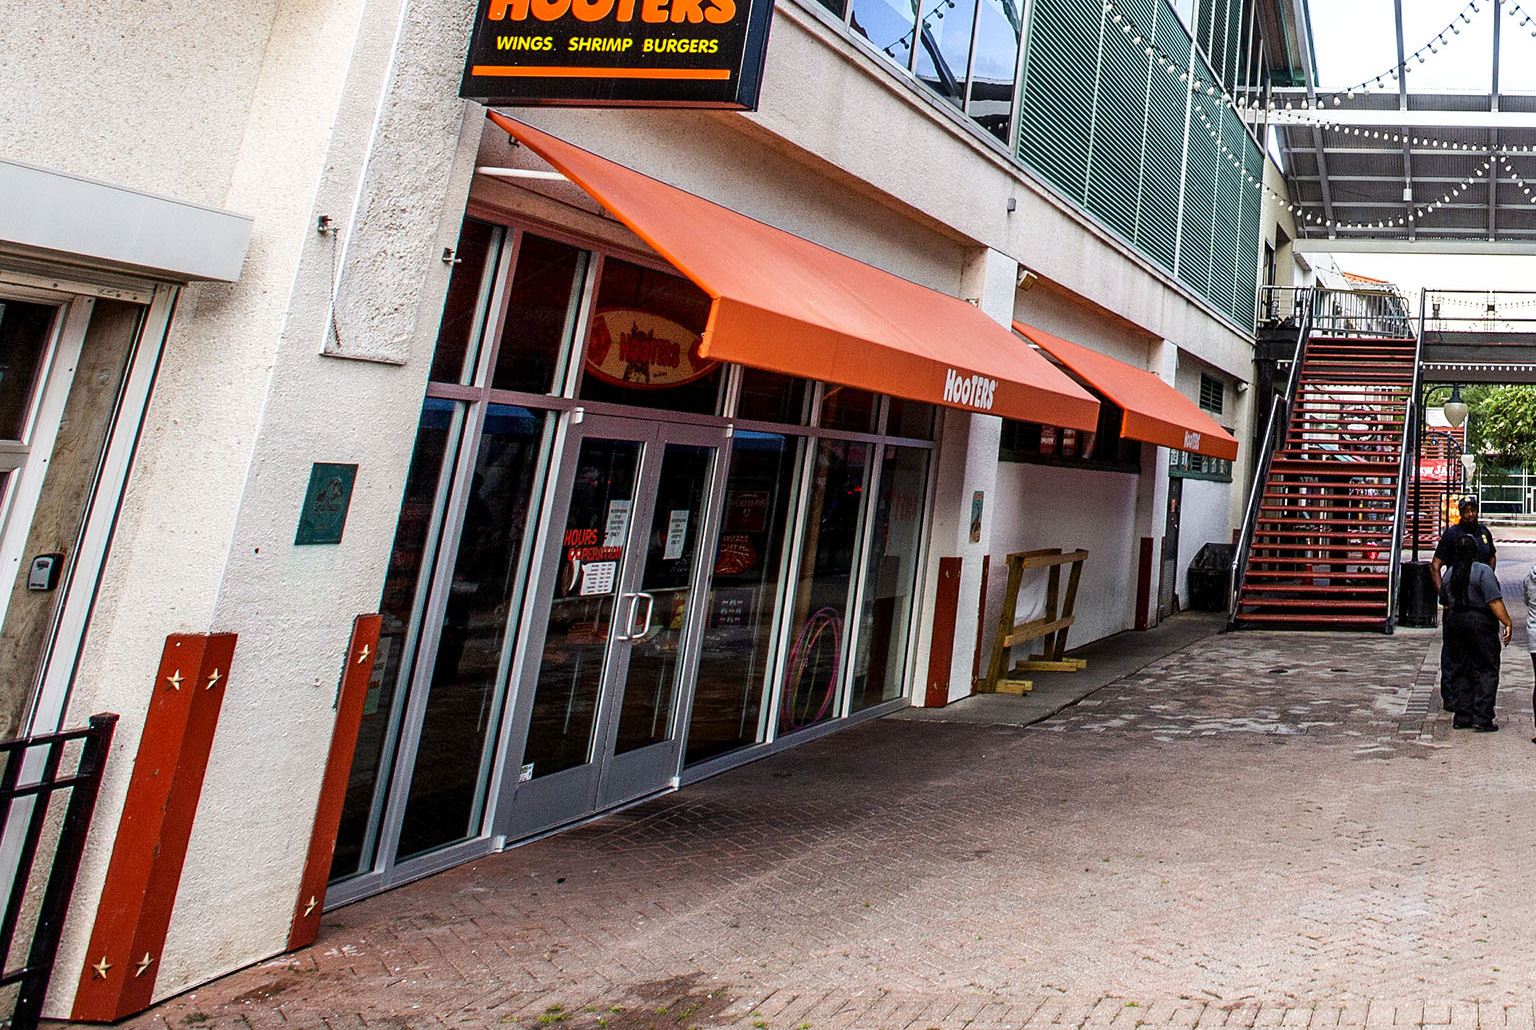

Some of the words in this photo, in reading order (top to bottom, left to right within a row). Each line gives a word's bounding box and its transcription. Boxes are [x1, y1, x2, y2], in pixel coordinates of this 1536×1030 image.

[496, 36, 554, 51] WINGS
[568, 37, 633, 52] SHRIMP
[642, 38, 719, 53] BURGERS
[619, 331, 680, 369] HOOTERS
[943, 368, 997, 410] HOOTERS
[563, 528, 599, 547] HOURS
